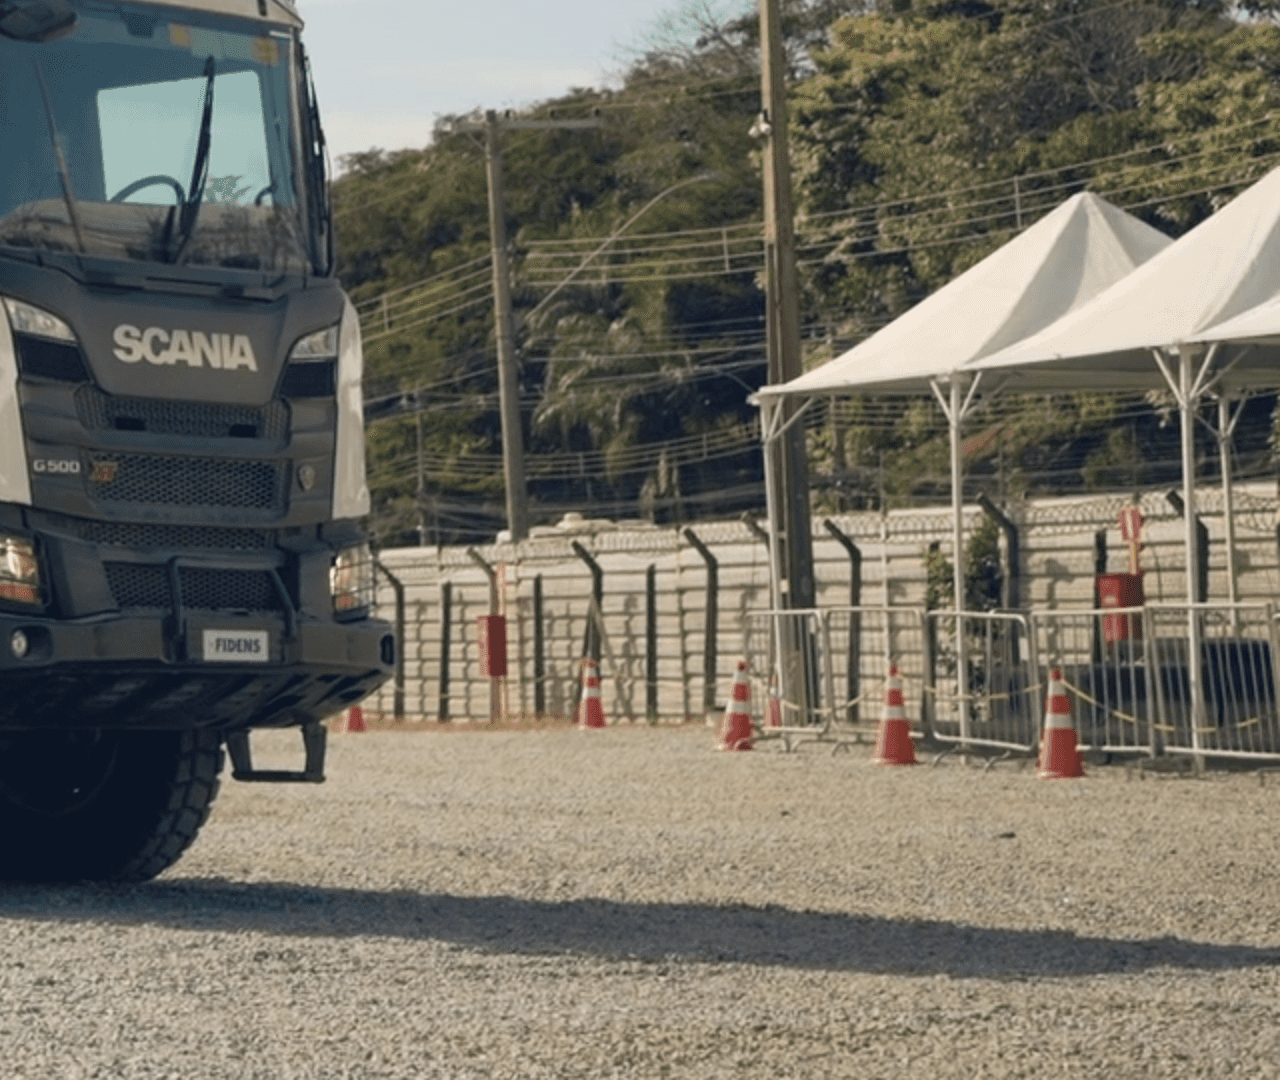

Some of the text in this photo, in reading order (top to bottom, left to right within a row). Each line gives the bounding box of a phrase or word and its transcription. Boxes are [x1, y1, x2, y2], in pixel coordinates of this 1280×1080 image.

[112, 324, 259, 372] SCANIA
[33, 459, 81, 473] G 500
[214, 637, 261, 654] FIDENS
